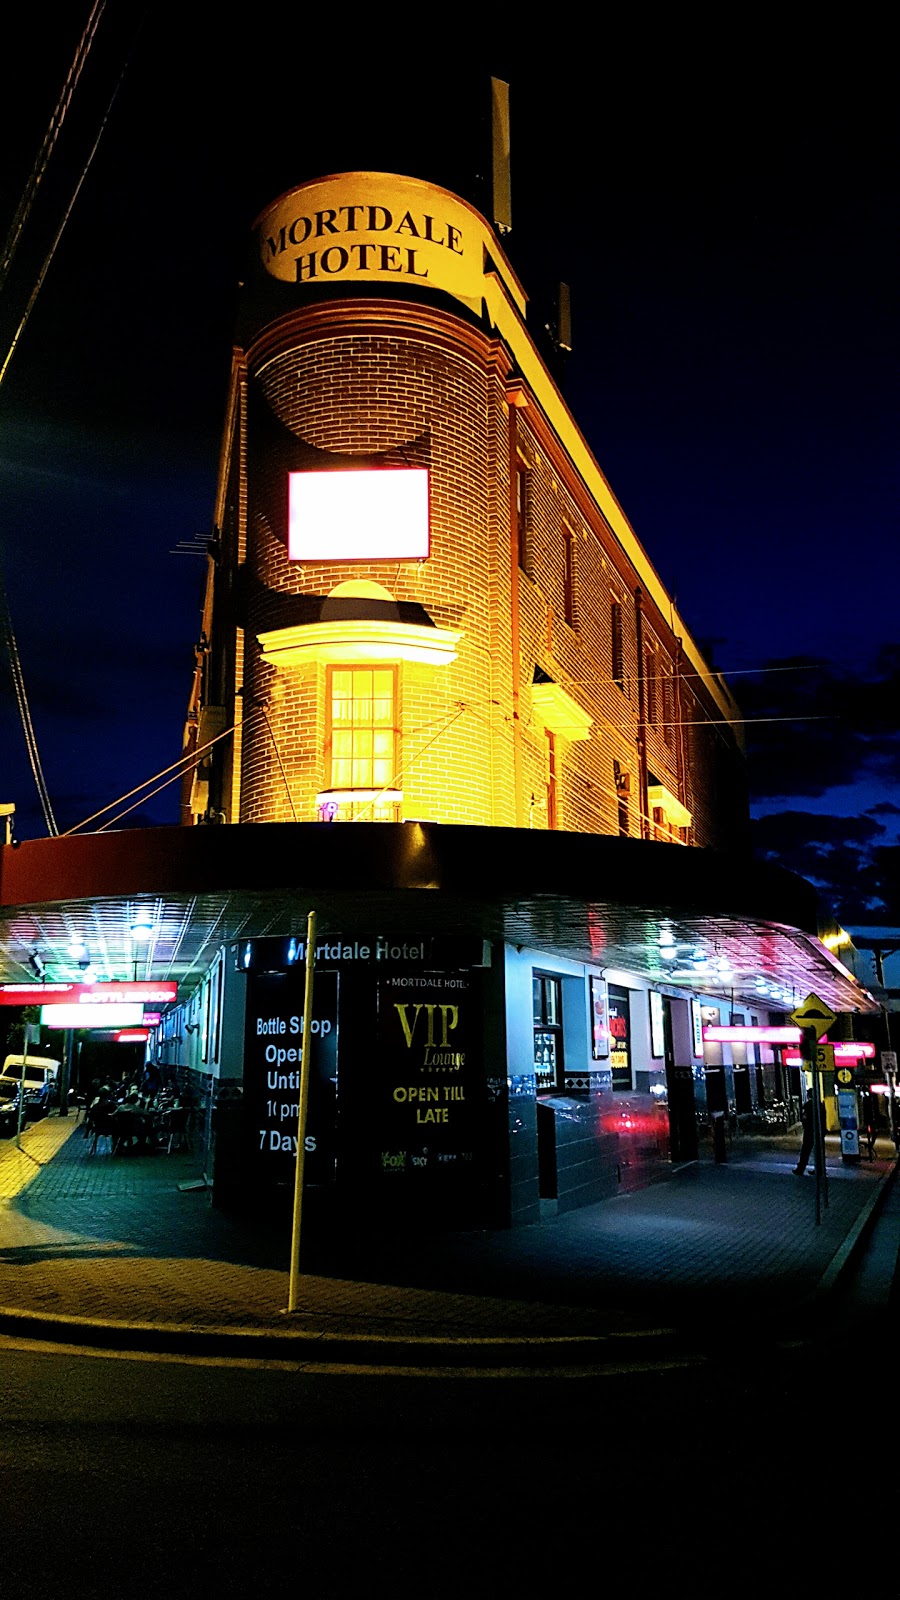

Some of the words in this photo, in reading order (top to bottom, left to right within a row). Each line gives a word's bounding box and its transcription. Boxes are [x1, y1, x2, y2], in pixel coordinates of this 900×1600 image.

[267, 205, 464, 257] MORTDALE
[294, 244, 429, 283] HOTEL
[375, 941, 425, 960] Hotel
[391, 977, 442, 988] MORTDALE
[256, 1017, 287, 1036] Bottle
[394, 1003, 459, 1048] VIP
[422, 1048, 466, 1070] Lounge
[393, 1087, 439, 1102] OPEN
[443, 1086, 466, 1101] TILL
[416, 1108, 449, 1124] LATE
[259, 1130, 267, 1151] 7
